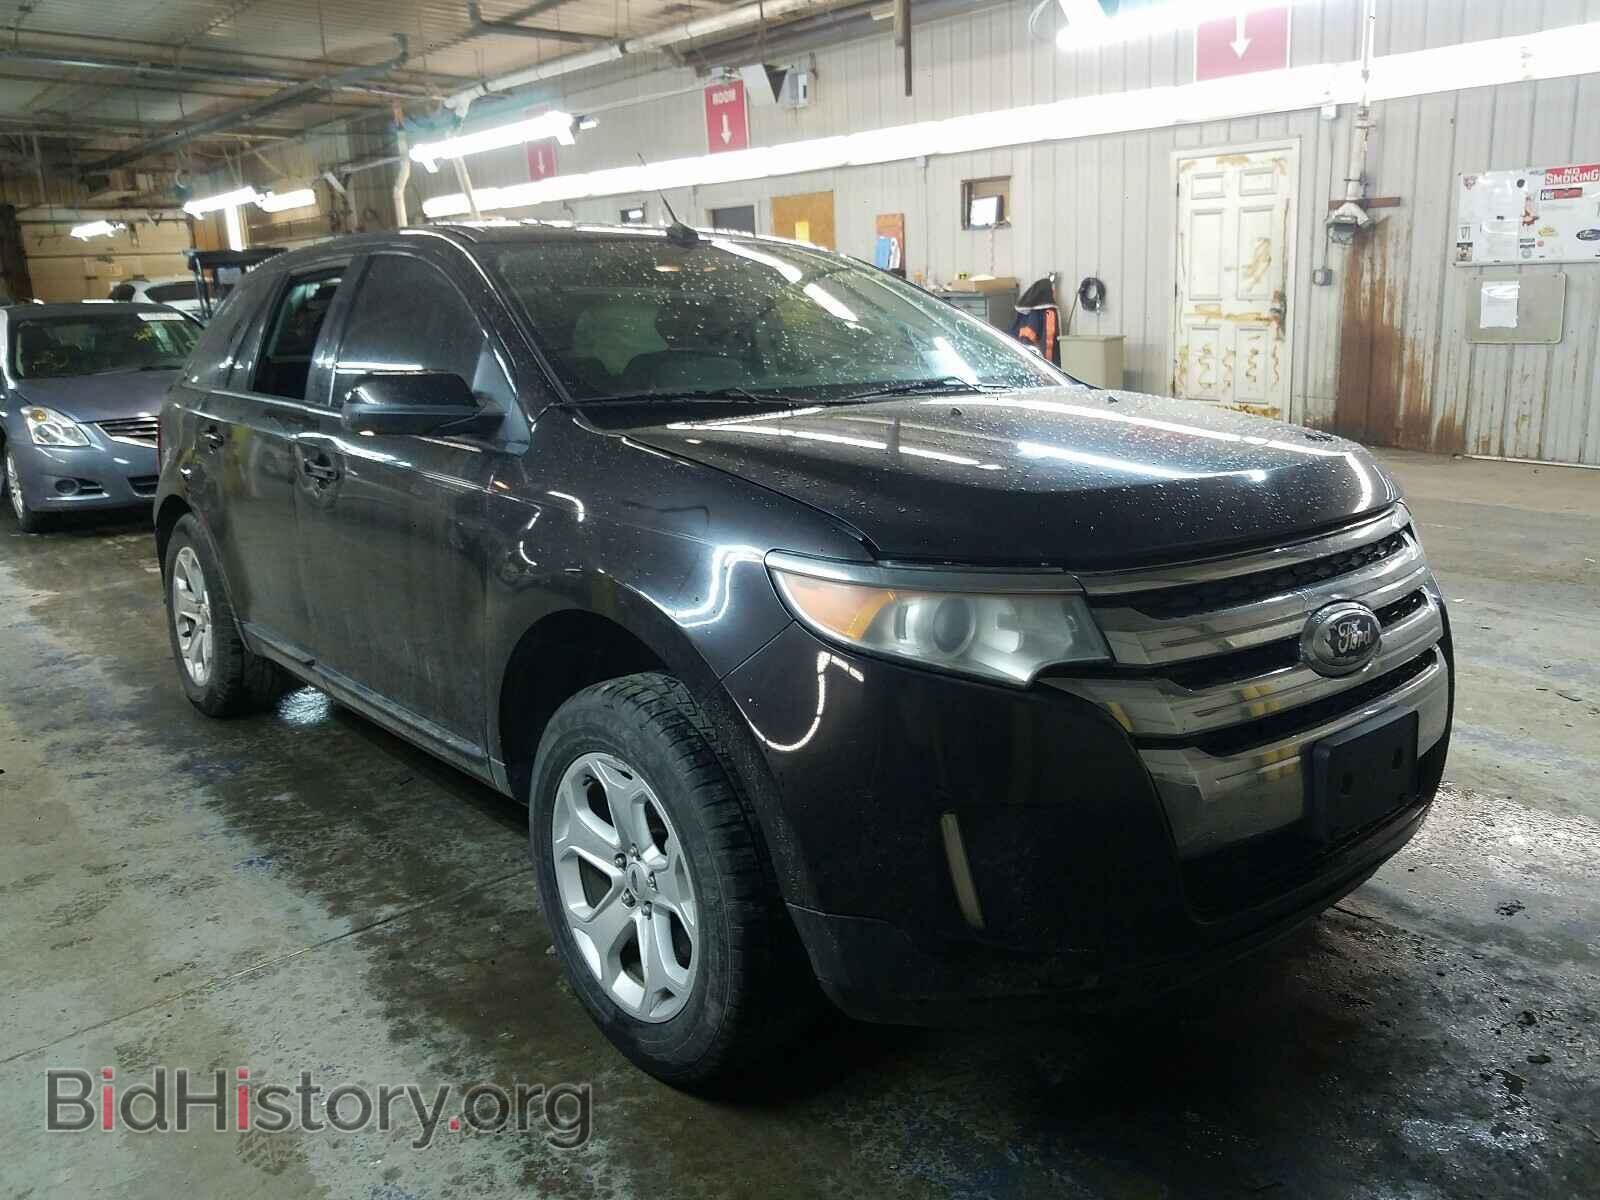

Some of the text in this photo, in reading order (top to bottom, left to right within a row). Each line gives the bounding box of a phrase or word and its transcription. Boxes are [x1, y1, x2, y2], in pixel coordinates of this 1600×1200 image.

[712, 88, 736, 105] ROOM
[1545, 168, 1599, 185] SMOKING
[1564, 167, 1580, 177] NO
[1338, 619, 1371, 653] Ford
